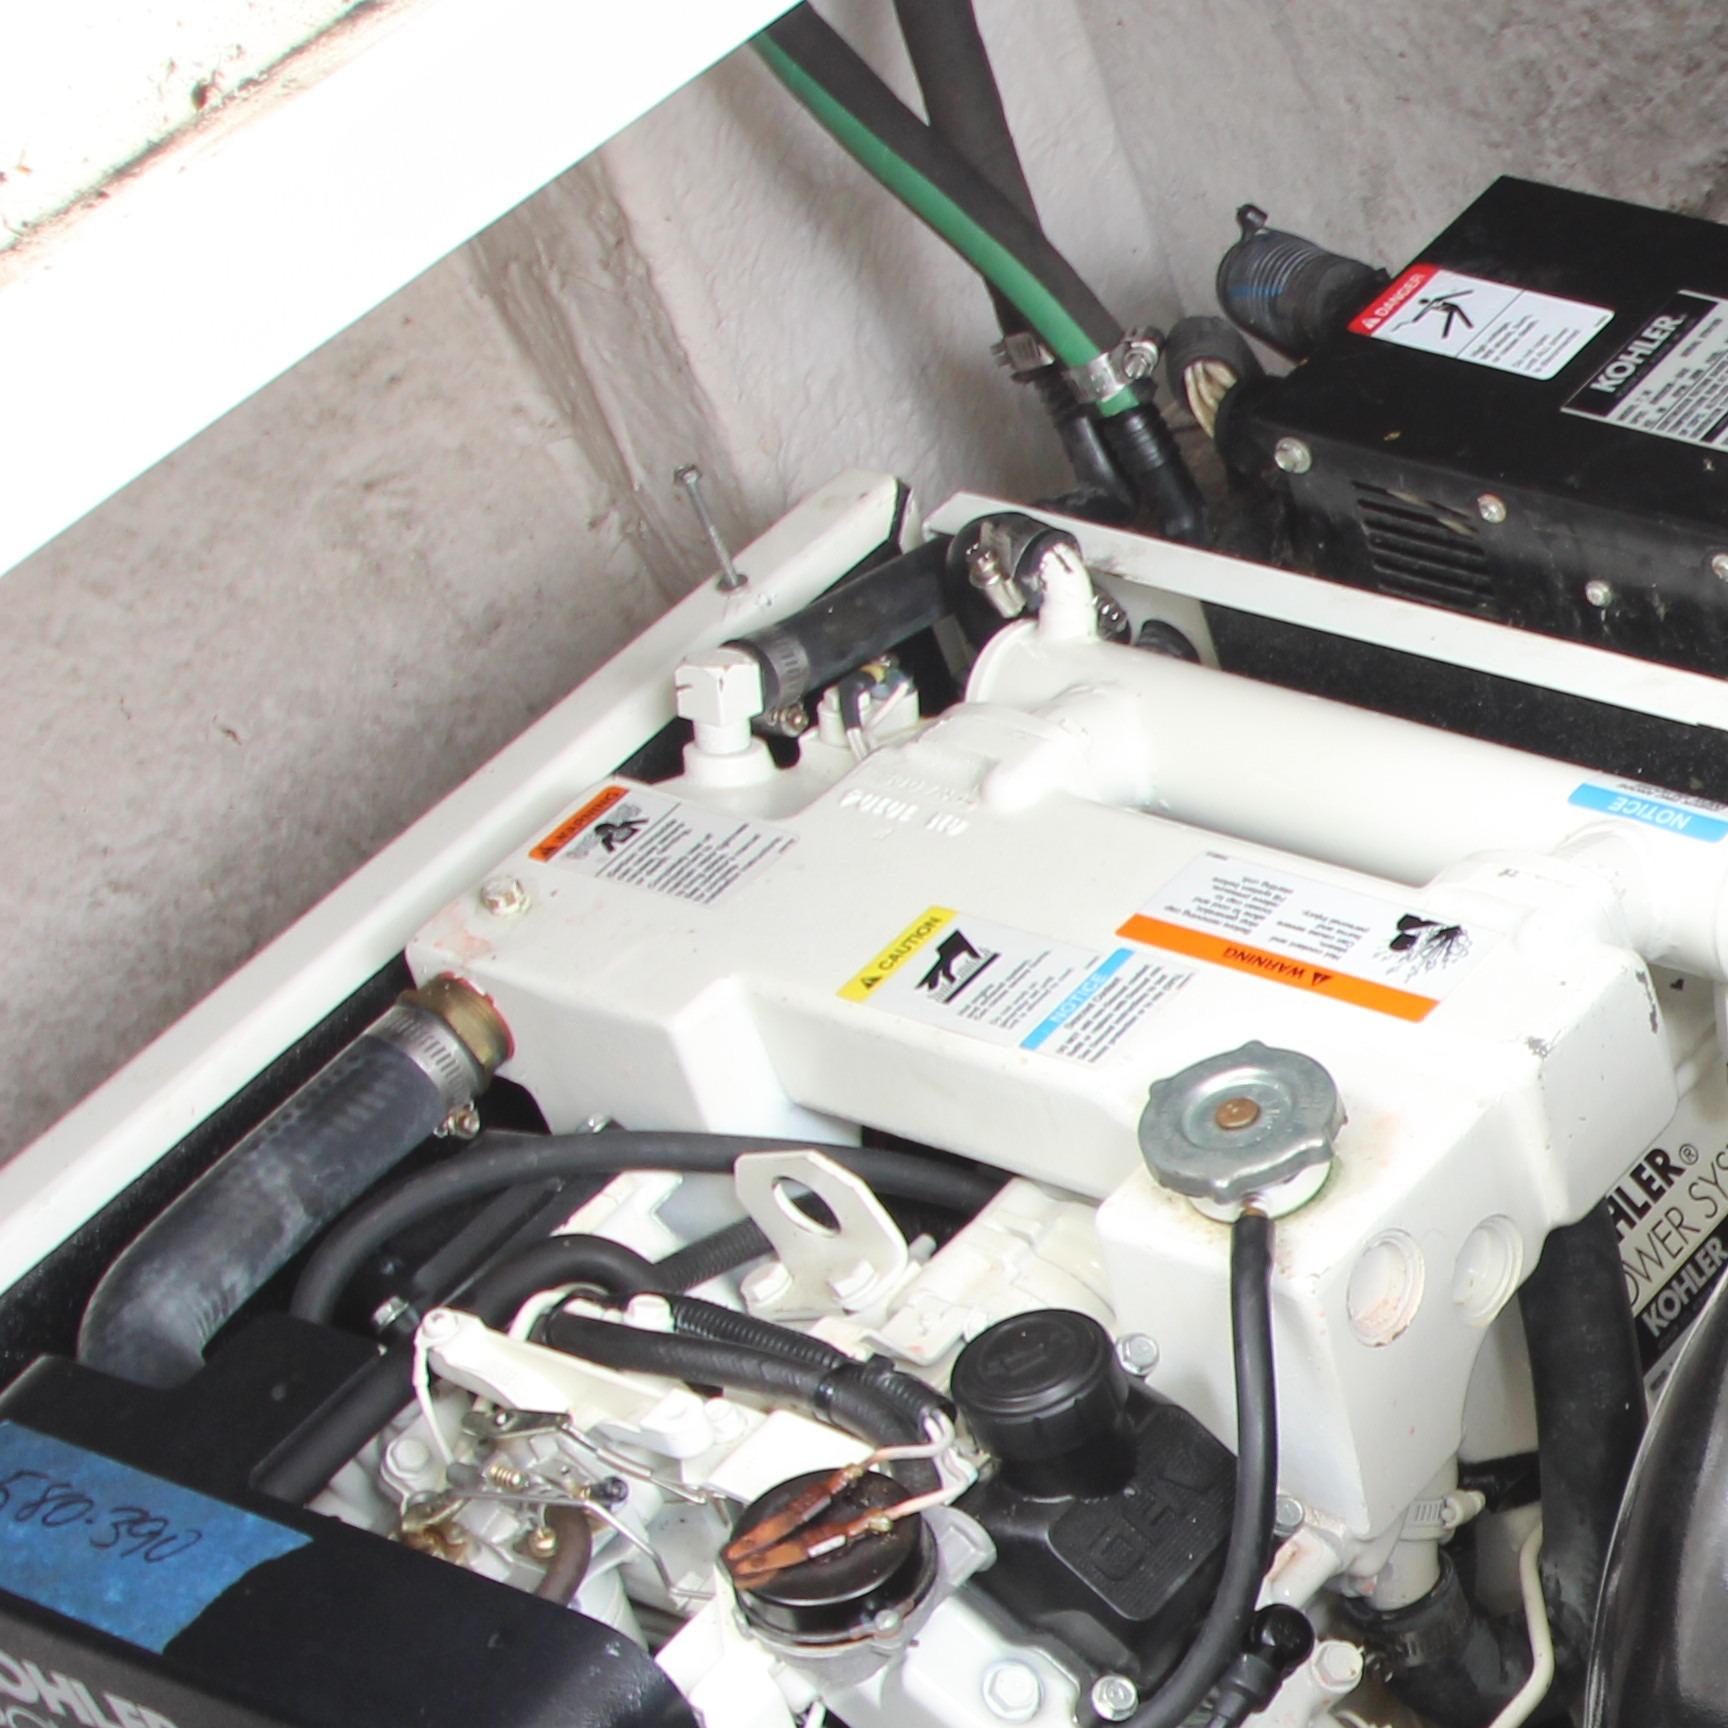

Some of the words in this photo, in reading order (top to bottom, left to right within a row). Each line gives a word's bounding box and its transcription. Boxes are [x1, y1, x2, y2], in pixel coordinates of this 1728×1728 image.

[1590, 316, 1682, 392] KOHLER
[1605, 795, 1693, 831] NOTICE
[874, 915, 943, 971] CAUTION
[1218, 945, 1309, 979] WARNING
[1048, 971, 1108, 1024] NOTICE
[1604, 1147, 1687, 1243] HLER
